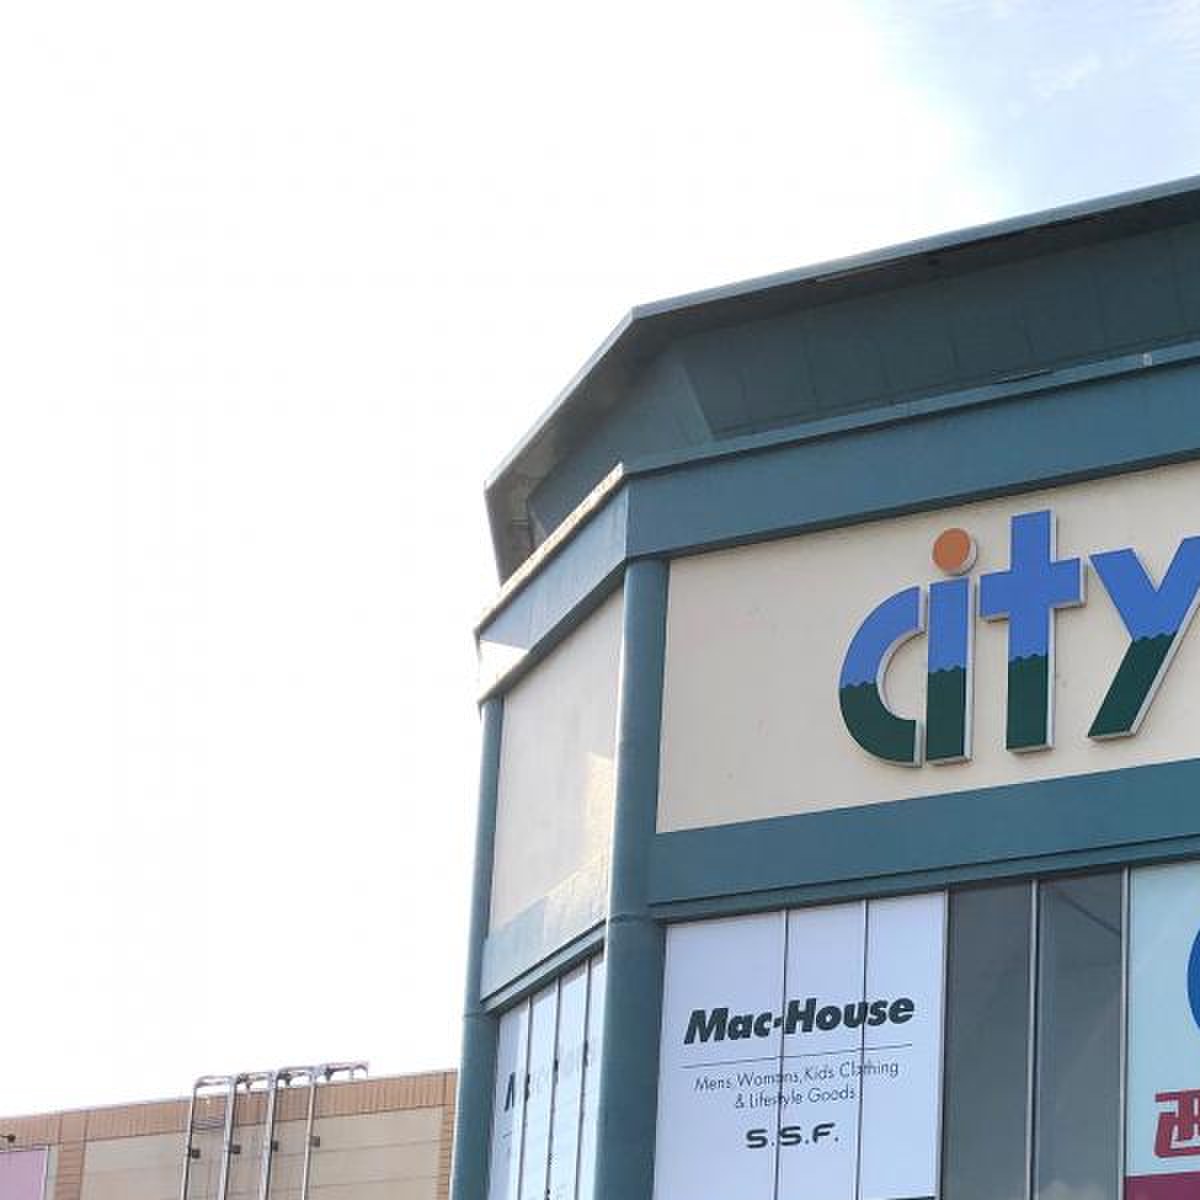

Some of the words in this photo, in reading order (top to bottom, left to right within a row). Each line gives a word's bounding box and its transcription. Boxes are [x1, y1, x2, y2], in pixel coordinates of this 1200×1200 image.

[683, 998, 914, 1044] Mac-House
[735, 1093, 745, 1108] &
[749, 1087, 801, 1108] Lifesyle
[807, 1084, 856, 1103] Goods
[745, 1122, 839, 1148] S.S.F.
